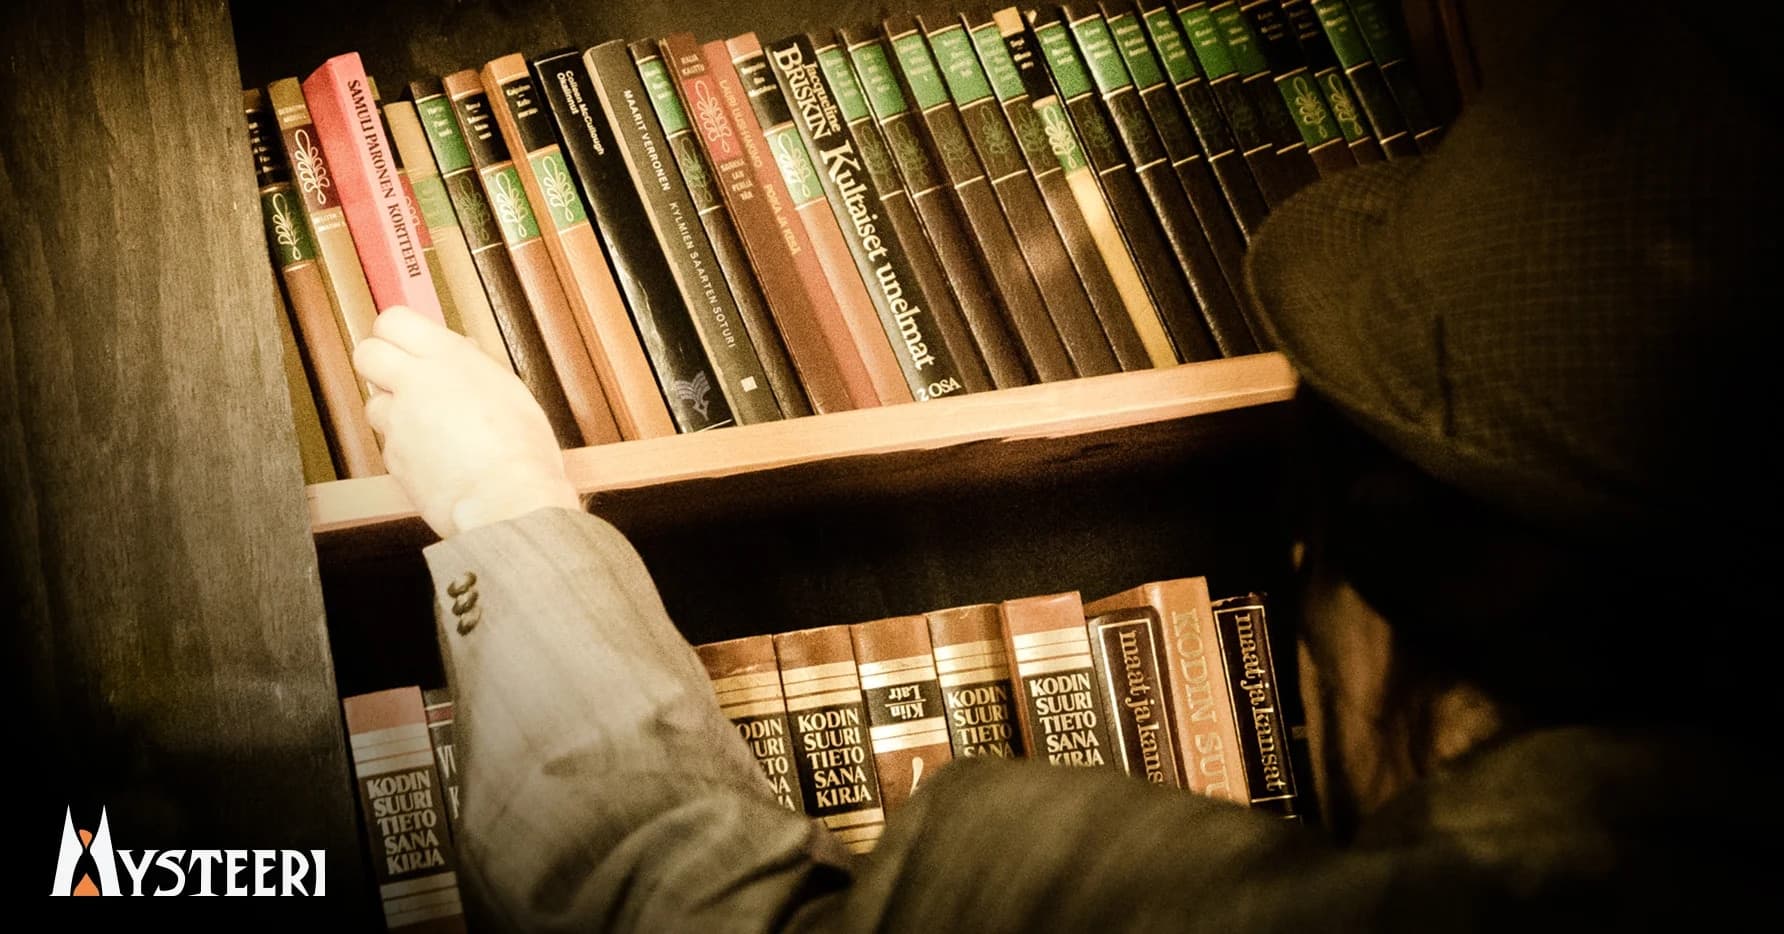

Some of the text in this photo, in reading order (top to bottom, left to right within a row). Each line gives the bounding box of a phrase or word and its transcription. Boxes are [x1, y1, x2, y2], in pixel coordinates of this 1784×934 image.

[773, 42, 832, 140] BRISKIN
[803, 62, 842, 133] Jacqueline
[565, 70, 605, 156] Colleen McCullough
[623, 89, 671, 192] MAARIT VERRONEN
[347, 79, 422, 278] SAMULI PARONEN KORTTEERI
[820, 139, 889, 263] Kultaiset
[876, 262, 936, 370] unelmat
[669, 202, 736, 348] KYLMIEN SAARTEN SOTURI
[928, 377, 962, 398] OSA
[1171, 608, 1217, 724] KODIN
[947, 685, 1008, 709] KODIN
[1029, 672, 1091, 698] KODIN
[953, 704, 1009, 727] SUURI
[1035, 691, 1094, 716] SUURI
[1118, 629, 1164, 785] maat ja kans
[1234, 613, 1288, 792] maat ja kansat
[737, 718, 783, 741] ODIN
[797, 707, 860, 733] KODIN
[1039, 710, 1097, 735] TIETO
[803, 726, 861, 751] SUURI
[957, 723, 1013, 746] TIETO
[1046, 730, 1100, 753] SANA
[806, 746, 865, 769] TIETO
[1049, 748, 1105, 767] KIRJA
[366, 770, 431, 799] KODIN
[814, 765, 867, 789] SANA
[373, 789, 433, 818] SUURI
[816, 784, 872, 808] KIRJA
[377, 808, 437, 836] TIETO
[384, 829, 440, 855] SANA
[386, 848, 445, 875] KIRJA
